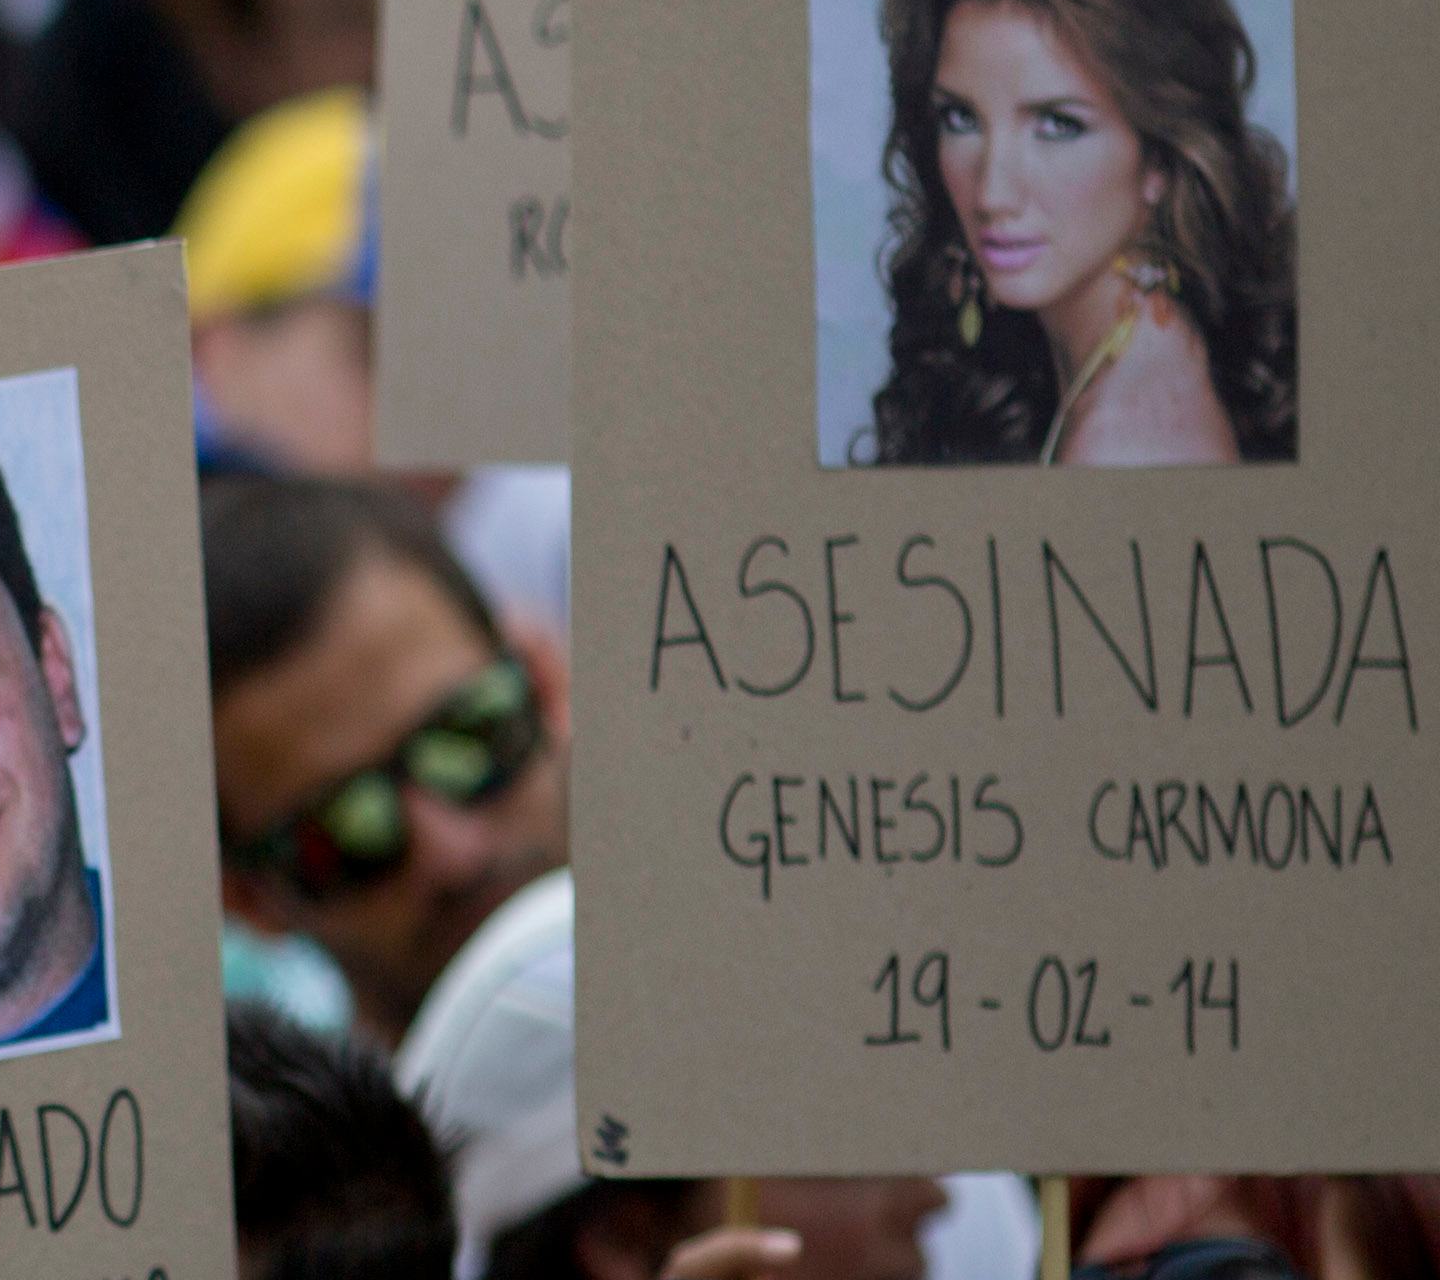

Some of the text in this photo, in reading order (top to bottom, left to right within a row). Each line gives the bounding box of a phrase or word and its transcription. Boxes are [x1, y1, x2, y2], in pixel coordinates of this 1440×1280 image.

[649, 534, 1419, 733] ASESINADA
[718, 773, 1394, 902] GENESIS CARMONA
